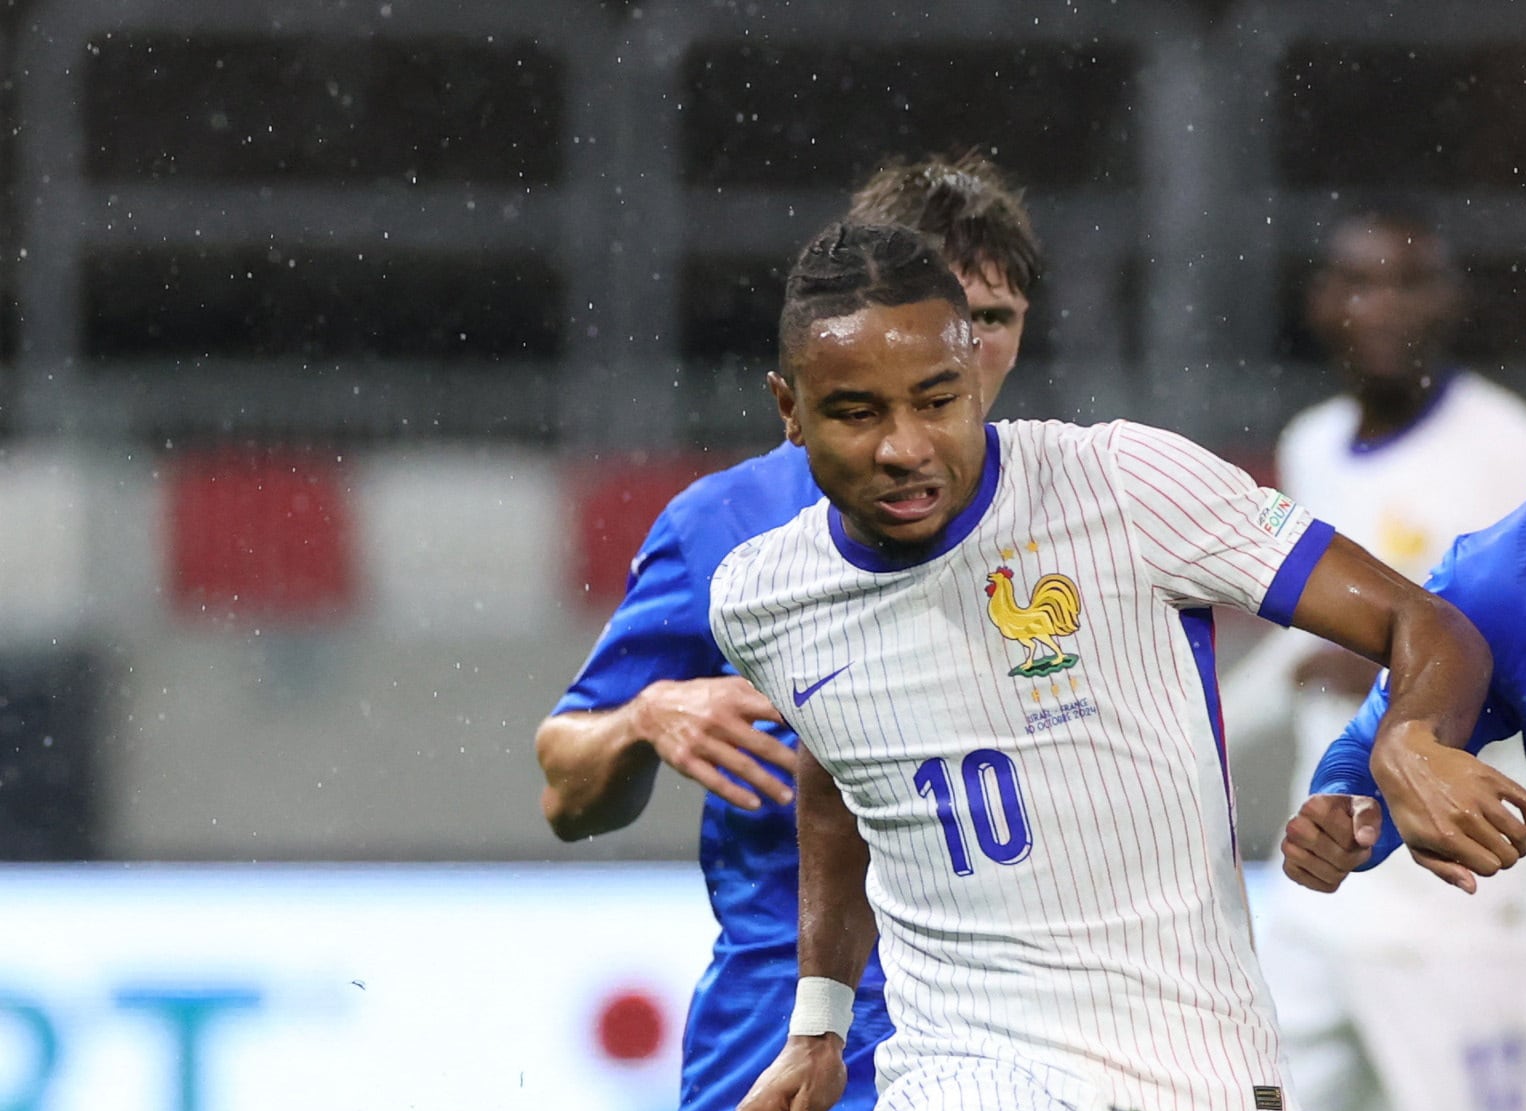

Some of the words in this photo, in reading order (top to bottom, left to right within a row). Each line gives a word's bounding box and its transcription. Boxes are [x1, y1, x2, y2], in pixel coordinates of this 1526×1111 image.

[1059, 697, 1088, 712] FRANCE
[1024, 724, 1036, 735] 10
[1072, 705, 1097, 720] 2024
[913, 748, 1034, 877] 10
